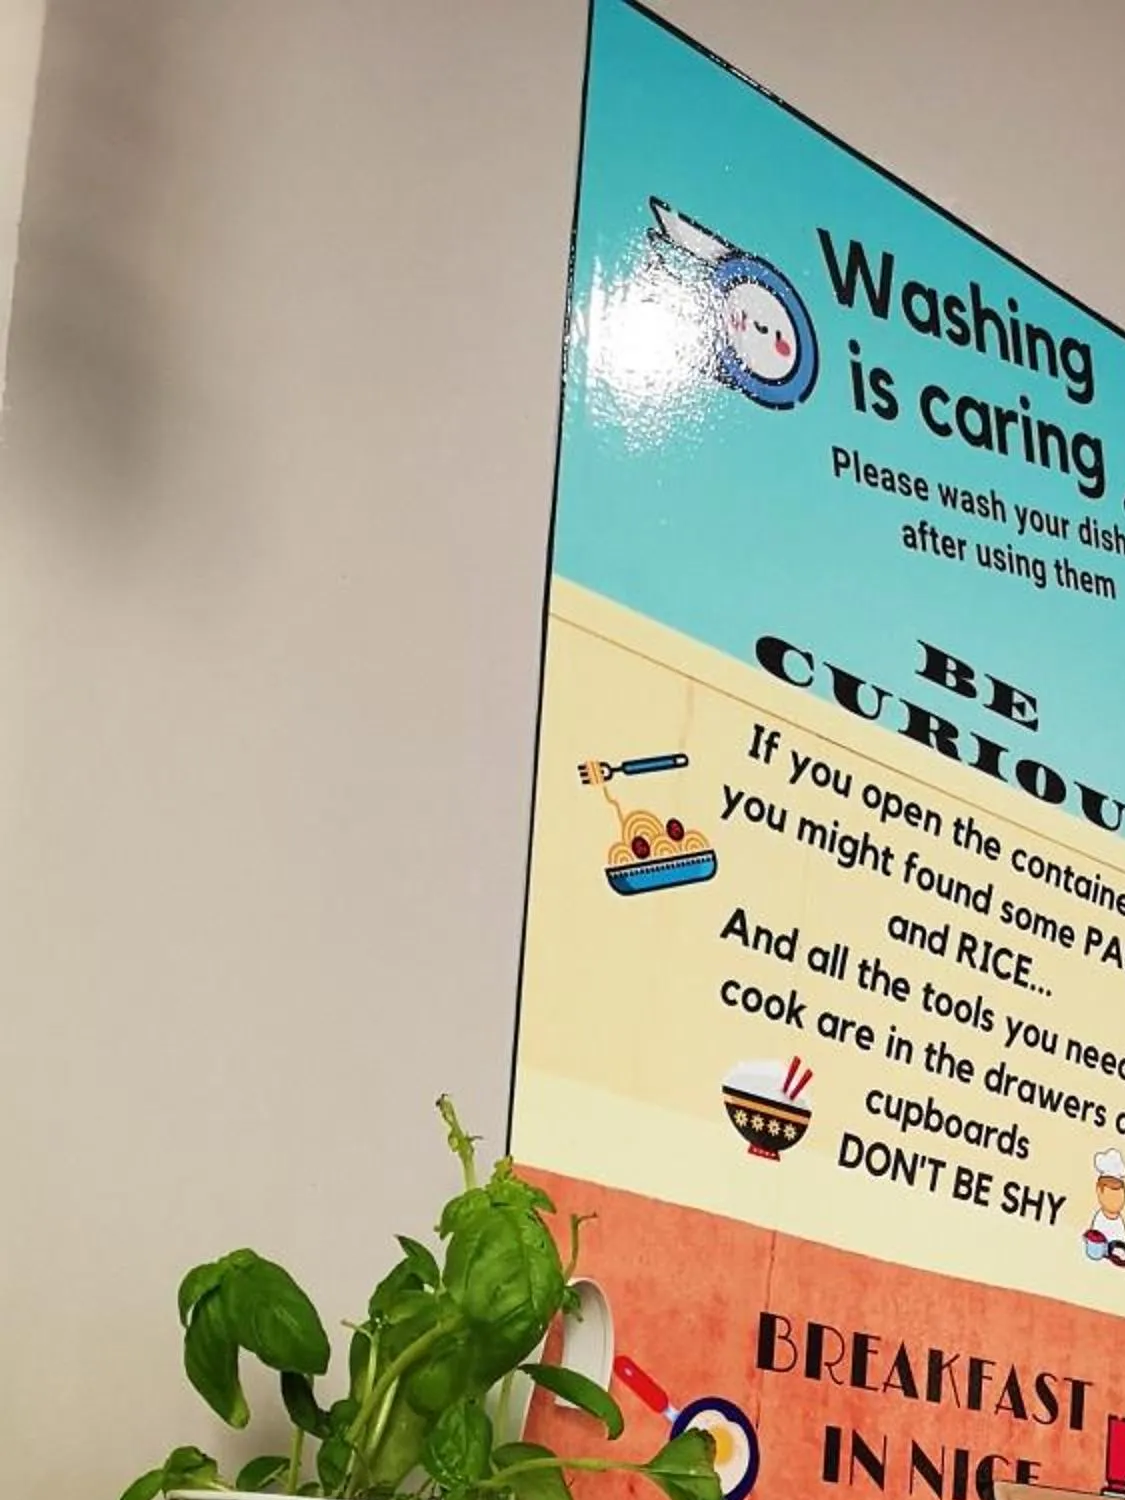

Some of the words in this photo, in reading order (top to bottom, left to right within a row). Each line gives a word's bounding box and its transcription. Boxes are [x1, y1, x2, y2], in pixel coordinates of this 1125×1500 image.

[816, 227, 1094, 404] Washing
[848, 339, 898, 422] is
[921, 385, 1104, 499] caring
[832, 446, 928, 501] Please
[937, 478, 1007, 523] wash
[1013, 501, 1069, 541] your
[901, 521, 966, 562] after
[976, 540, 1047, 588] using
[1054, 559, 1117, 600] them
[916, 640, 1039, 732] BE
[748, 725, 781, 764] If
[789, 748, 853, 799] you
[863, 784, 941, 837] open
[953, 817, 1001, 861] the
[721, 784, 787, 834] you
[797, 813, 894, 877] might
[904, 853, 993, 915] found
[999, 901, 1075, 949] some
[720, 908, 799, 964] And
[807, 944, 848, 980] all
[858, 959, 910, 1002] the
[922, 982, 994, 1033] tools
[1005, 1015, 1059, 1055] you
[888, 914, 950, 956] and
[956, 932, 1052, 996] RICE...
[721, 979, 807, 1030] cook
[817, 1010, 874, 1050] are
[886, 1025, 914, 1063] in
[924, 1042, 974, 1083] the
[985, 1063, 1107, 1127] drawers
[866, 1088, 1030, 1159] cupboards
[838, 1133, 946, 1193] DON'T
[953, 1167, 992, 1201] BE
[1002, 1181, 1067, 1226] SHY
[756, 1311, 1095, 1431] BREAKFAST
[822, 1426, 888, 1492] IN
